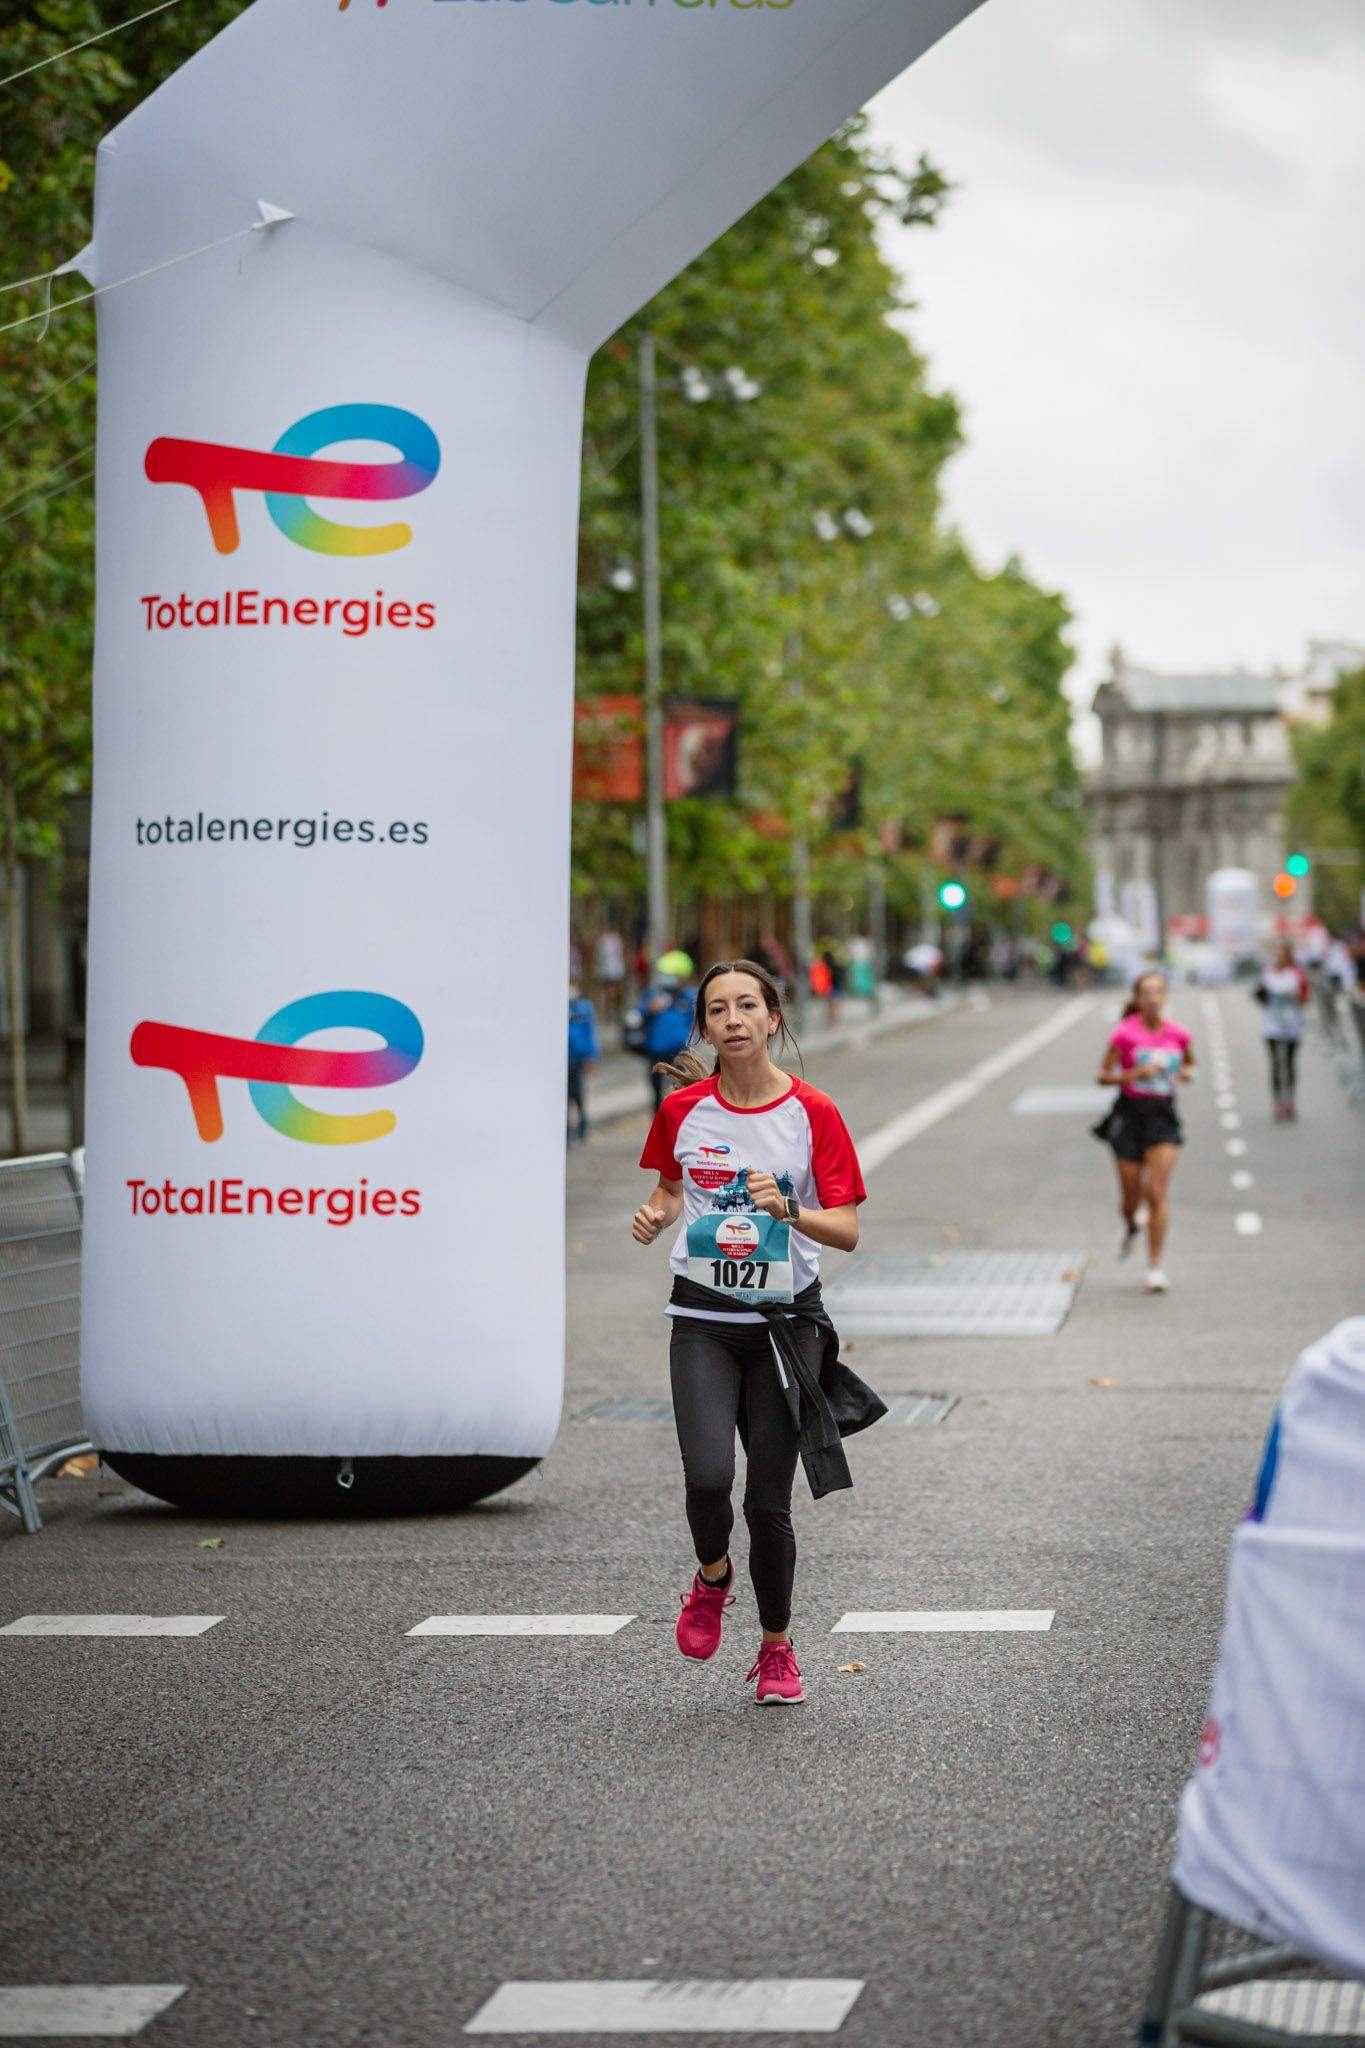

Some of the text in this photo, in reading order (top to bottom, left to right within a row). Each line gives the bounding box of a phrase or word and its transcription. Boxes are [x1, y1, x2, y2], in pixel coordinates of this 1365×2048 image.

[141, 590, 436, 637] TotalEnergies
[136, 812, 428, 847] totalenergies.es
[127, 1178, 421, 1227] TotalEnergies
[710, 1259, 770, 1289] 1027
